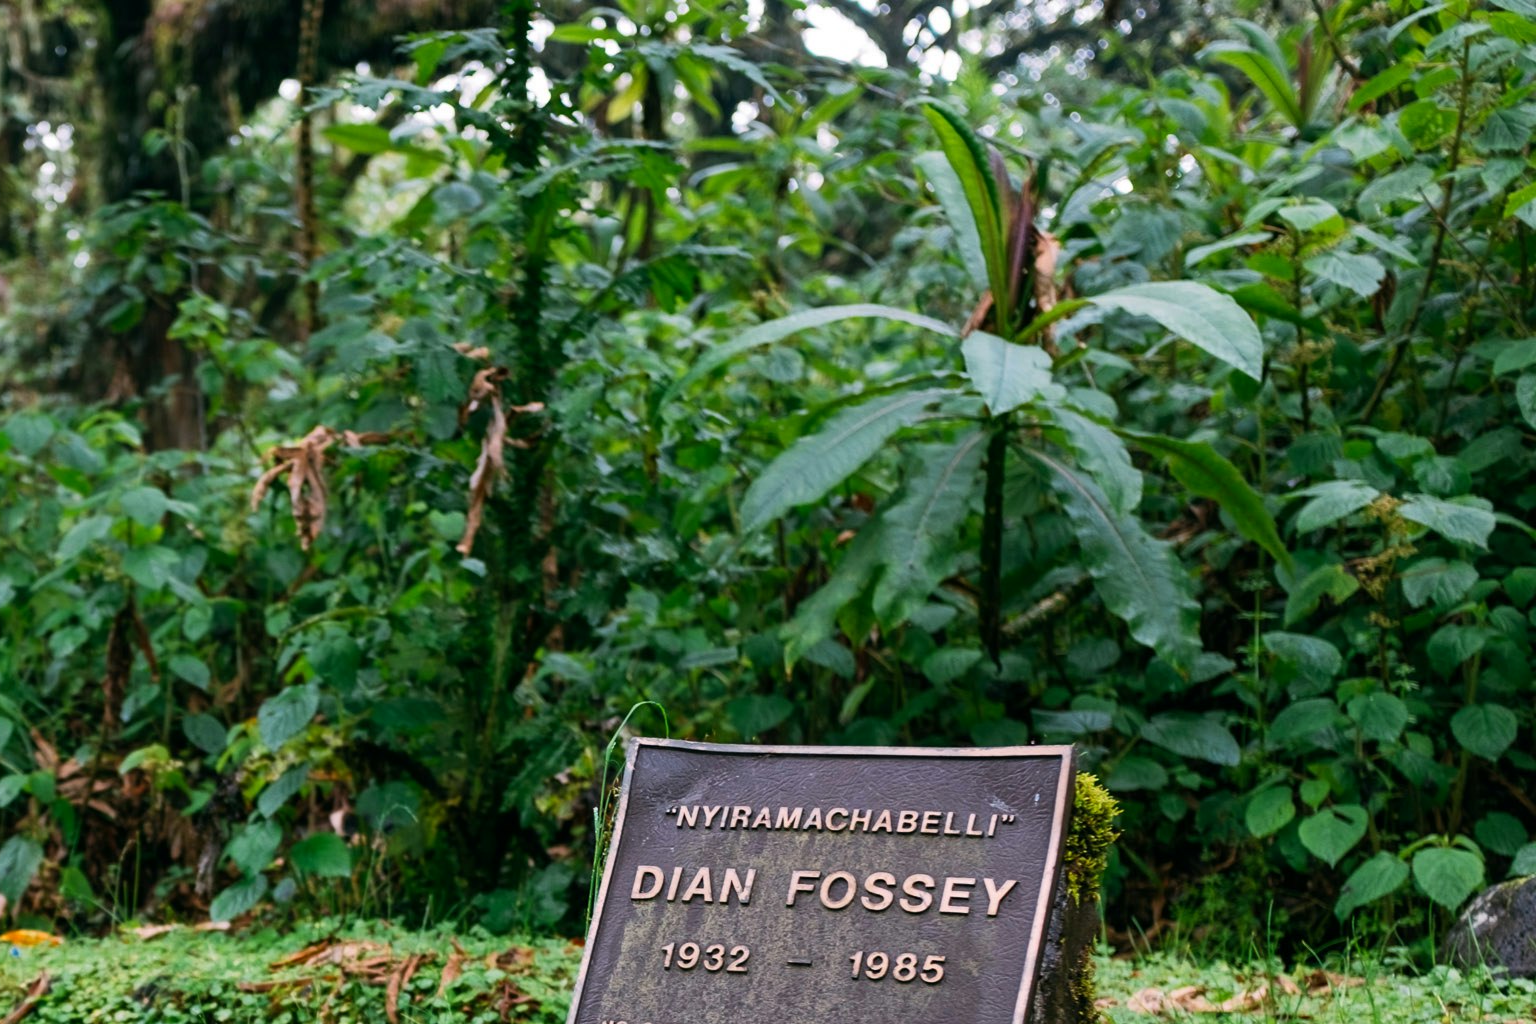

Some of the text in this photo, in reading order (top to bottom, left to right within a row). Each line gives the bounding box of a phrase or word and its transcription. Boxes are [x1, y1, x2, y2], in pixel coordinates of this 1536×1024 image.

[630, 865, 1018, 916] DIAN FOSSEY
[660, 942, 750, 973] 1932
[849, 951, 946, 984] 1985
